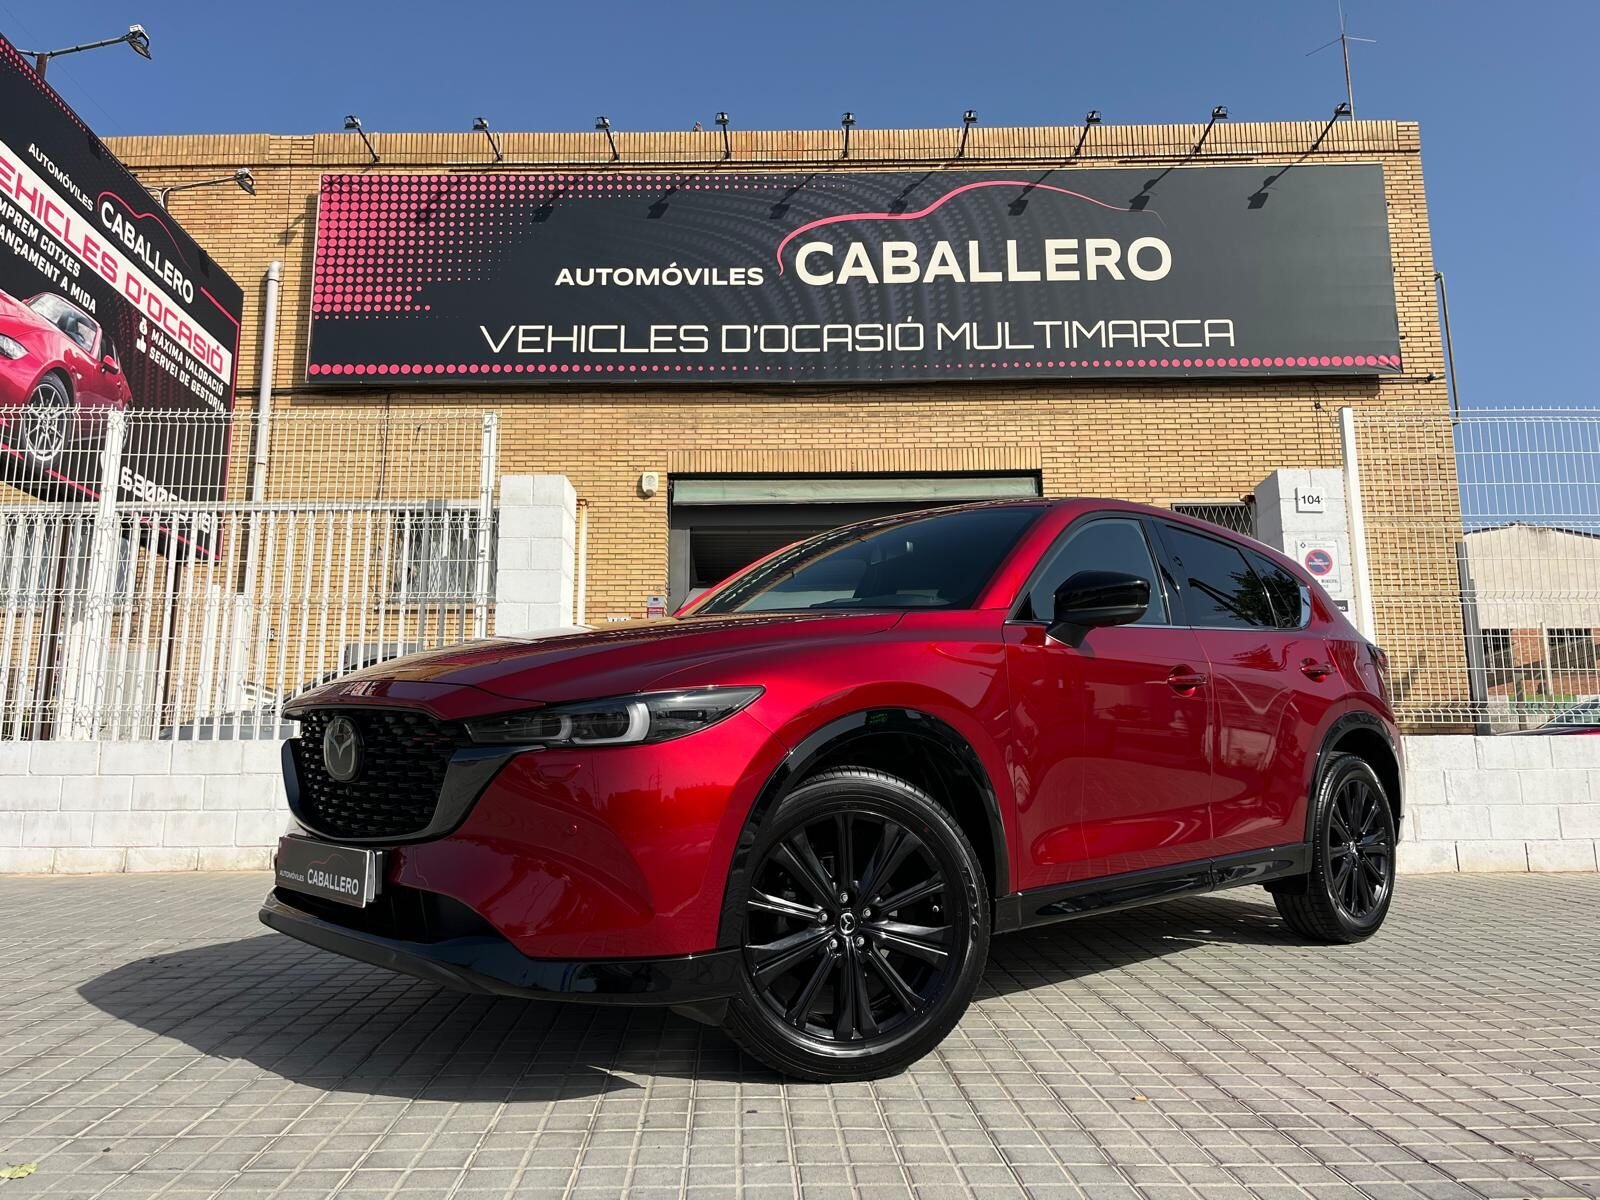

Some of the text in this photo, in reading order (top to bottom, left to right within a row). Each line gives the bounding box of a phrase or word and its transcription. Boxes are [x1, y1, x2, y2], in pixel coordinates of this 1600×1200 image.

[28, 143, 194, 304] AUTOMÓVILES CABALLERO
[39, 234, 81, 278] COTXES
[554, 236, 1173, 286] AUTOMÓVILES CABALLERO
[60, 275, 69, 292] A
[70, 282, 96, 314] MIDA
[125, 271, 223, 375] D'OCASIÓ
[479, 316, 1236, 354] VEHICLES D'OCASIÓ MULTIMARCA
[148, 346, 225, 413] SERVEI DE GESTORIA
[184, 355, 224, 397] VALORACIÓ
[1301, 494, 1321, 505] 104
[279, 868, 360, 896] AUTOMÓVILES CABALLERO
